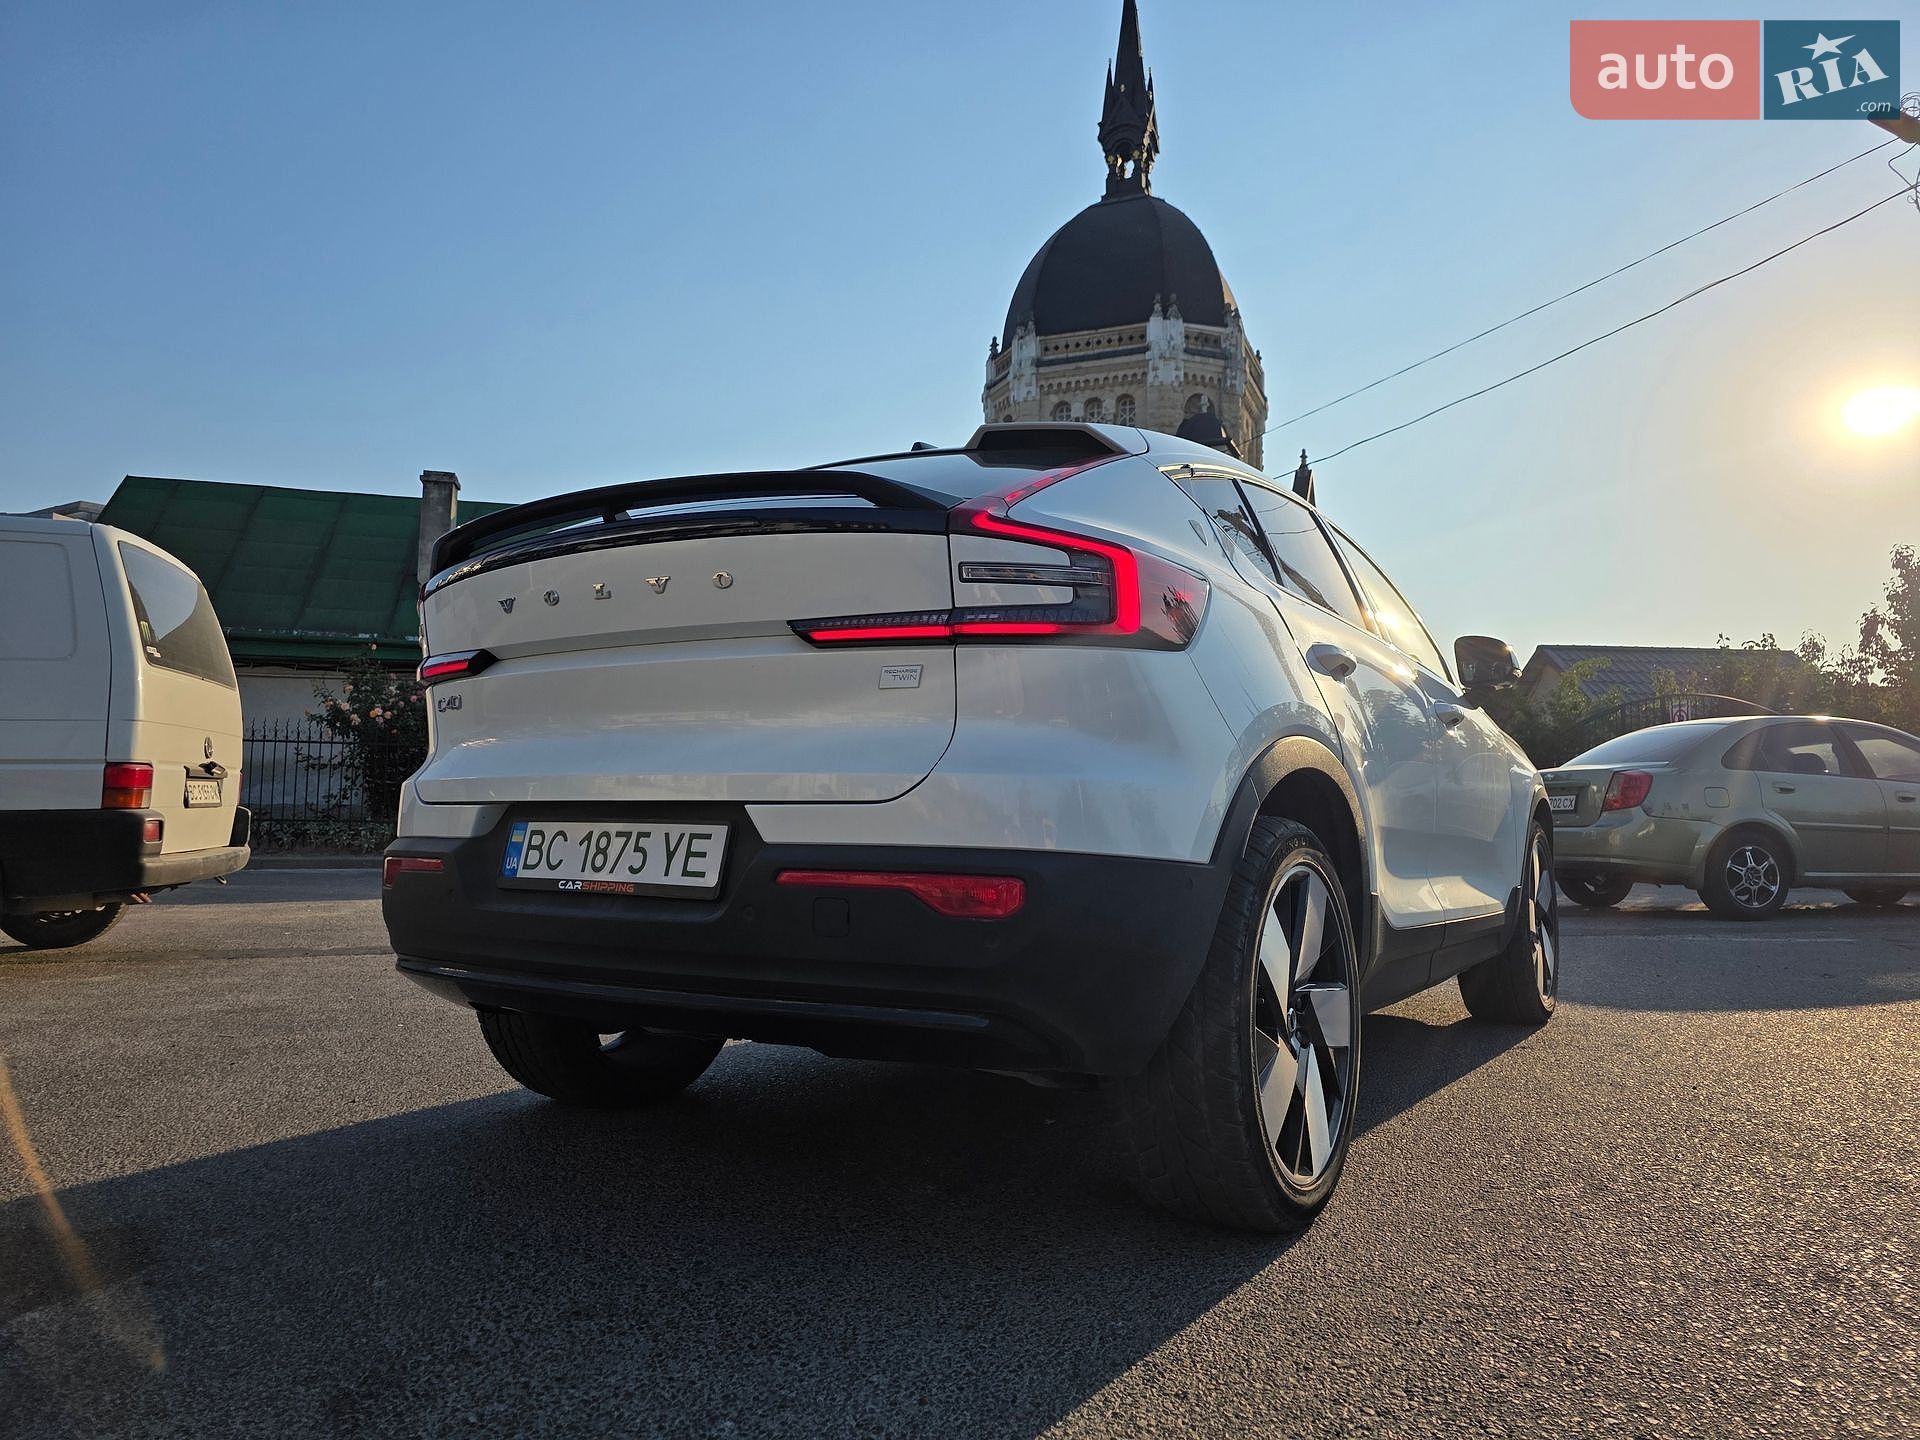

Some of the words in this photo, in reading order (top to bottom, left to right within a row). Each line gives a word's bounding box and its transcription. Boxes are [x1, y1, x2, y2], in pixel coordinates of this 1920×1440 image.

[497, 570, 734, 614] VOLVO
[891, 673, 917, 681] TWIN
[1562, 797, 1575, 809] CX
[522, 829, 569, 871] BC
[578, 830, 652, 875] 1875
[663, 832, 713, 878] YE
[505, 856, 519, 870] UA
